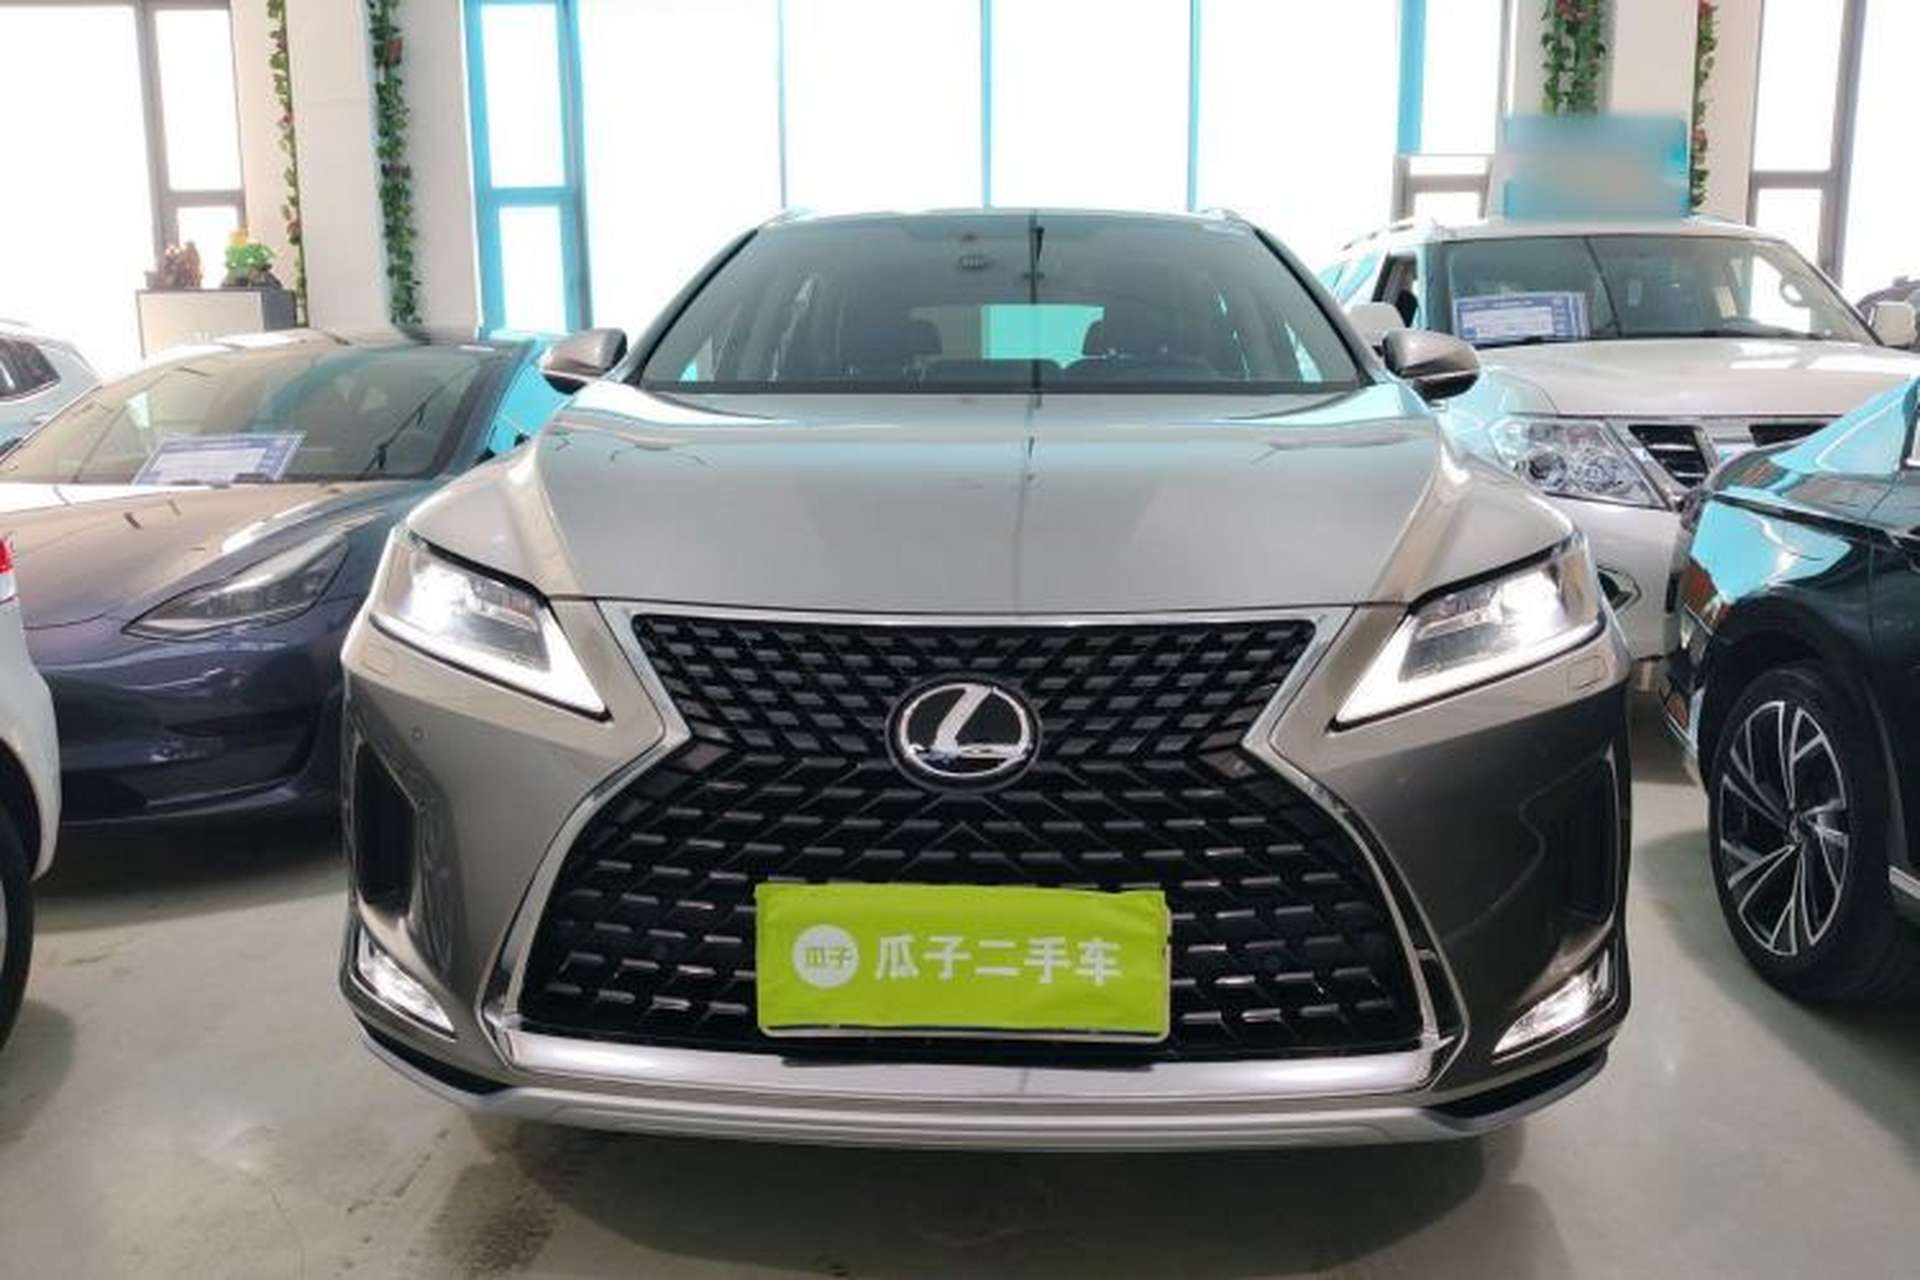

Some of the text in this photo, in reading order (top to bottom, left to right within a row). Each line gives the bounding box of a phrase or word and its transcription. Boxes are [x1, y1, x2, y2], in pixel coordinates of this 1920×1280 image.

[874, 933, 1123, 986] 瓜子二手车
